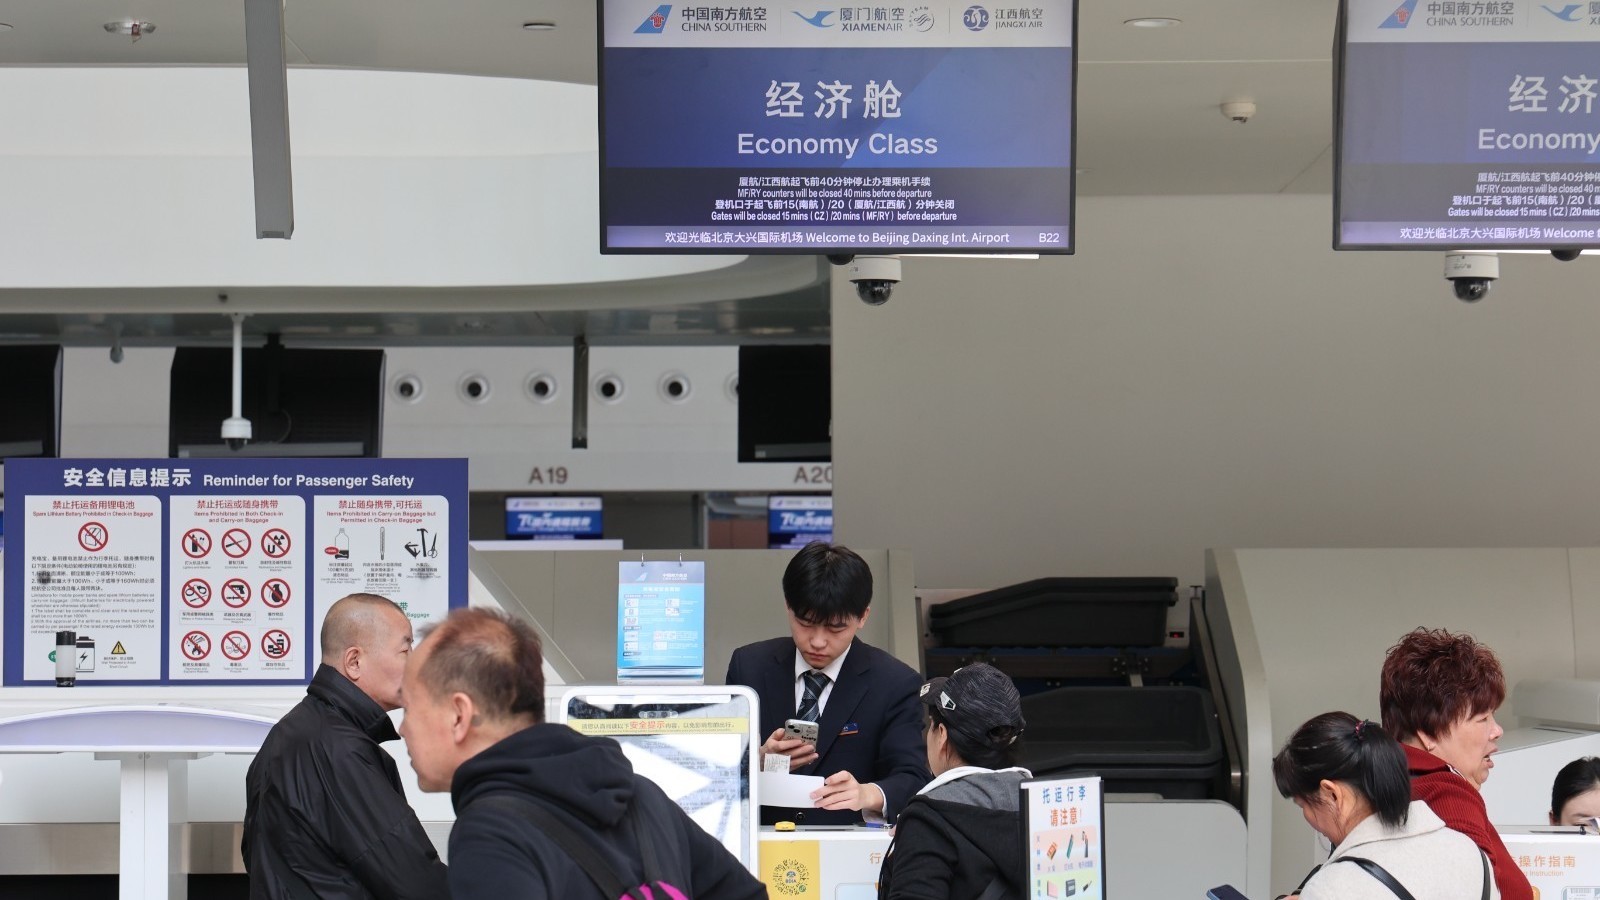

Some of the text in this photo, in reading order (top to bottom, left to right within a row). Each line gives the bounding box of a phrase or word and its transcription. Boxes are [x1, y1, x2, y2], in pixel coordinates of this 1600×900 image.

[682, 7, 767, 21] 中国南方航空
[840, 7, 904, 21] 厦门航空
[995, 8, 1043, 20] 江西航空
[1427, 1, 1514, 15] 中国南方航空
[681, 22, 767, 32] CHINA SOUTHERN
[841, 23, 903, 32] XIAMENAIR
[995, 21, 1026, 29] JIANGXI
[1426, 17, 1514, 26] CHINA SOUTHERN
[765, 79, 902, 119] 经济舱
[1508, 74, 1598, 113] 经济
[738, 132, 939, 159] Economy Class
[1478, 128, 1600, 154] Economy
[737, 188, 932, 200] MF/RY counters will be closed 40 mins before departure
[1476, 184, 1500, 194] MF/RY
[1501, 184, 1534, 194] counters
[1535, 184, 1548, 194] will
[1549, 184, 1558, 194] be
[1559, 184, 1583, 194] closed
[1584, 184, 1594, 194] 40
[711, 211, 733, 221] Gates
[733, 211, 746, 221] will
[747, 211, 756, 221] be
[757, 211, 781, 221] closed
[782, 211, 790, 221] 15
[791, 211, 809, 221] mins
[842, 211, 860, 221] mins
[897, 211, 920, 221] before
[921, 211, 957, 223] departure
[1447, 207, 1470, 217] Gates
[1470, 207, 1483, 217] will
[1484, 207, 1494, 217] be
[1495, 207, 1519, 217] closed
[1520, 207, 1529, 217] 15
[1529, 207, 1547, 217] mins
[665, 231, 1010, 245] 欢迎光临北京大兴国际机场 Welcome to Beijing Daxing Int. Airport
[1039, 232, 1060, 243] B22
[1400, 227, 1541, 239] 欢迎光临北京大兴国际机场
[1544, 227, 1595, 239] Welcome
[63, 467, 414, 490] 安全信息提示 Reminder for Passenger Safety
[52, 500, 136, 510] 禁止托运备用锂电池
[197, 499, 279, 509] 禁止托运或随身携带
[1042, 785, 1086, 804] 托运行李
[869, 852, 881, 865] 行
